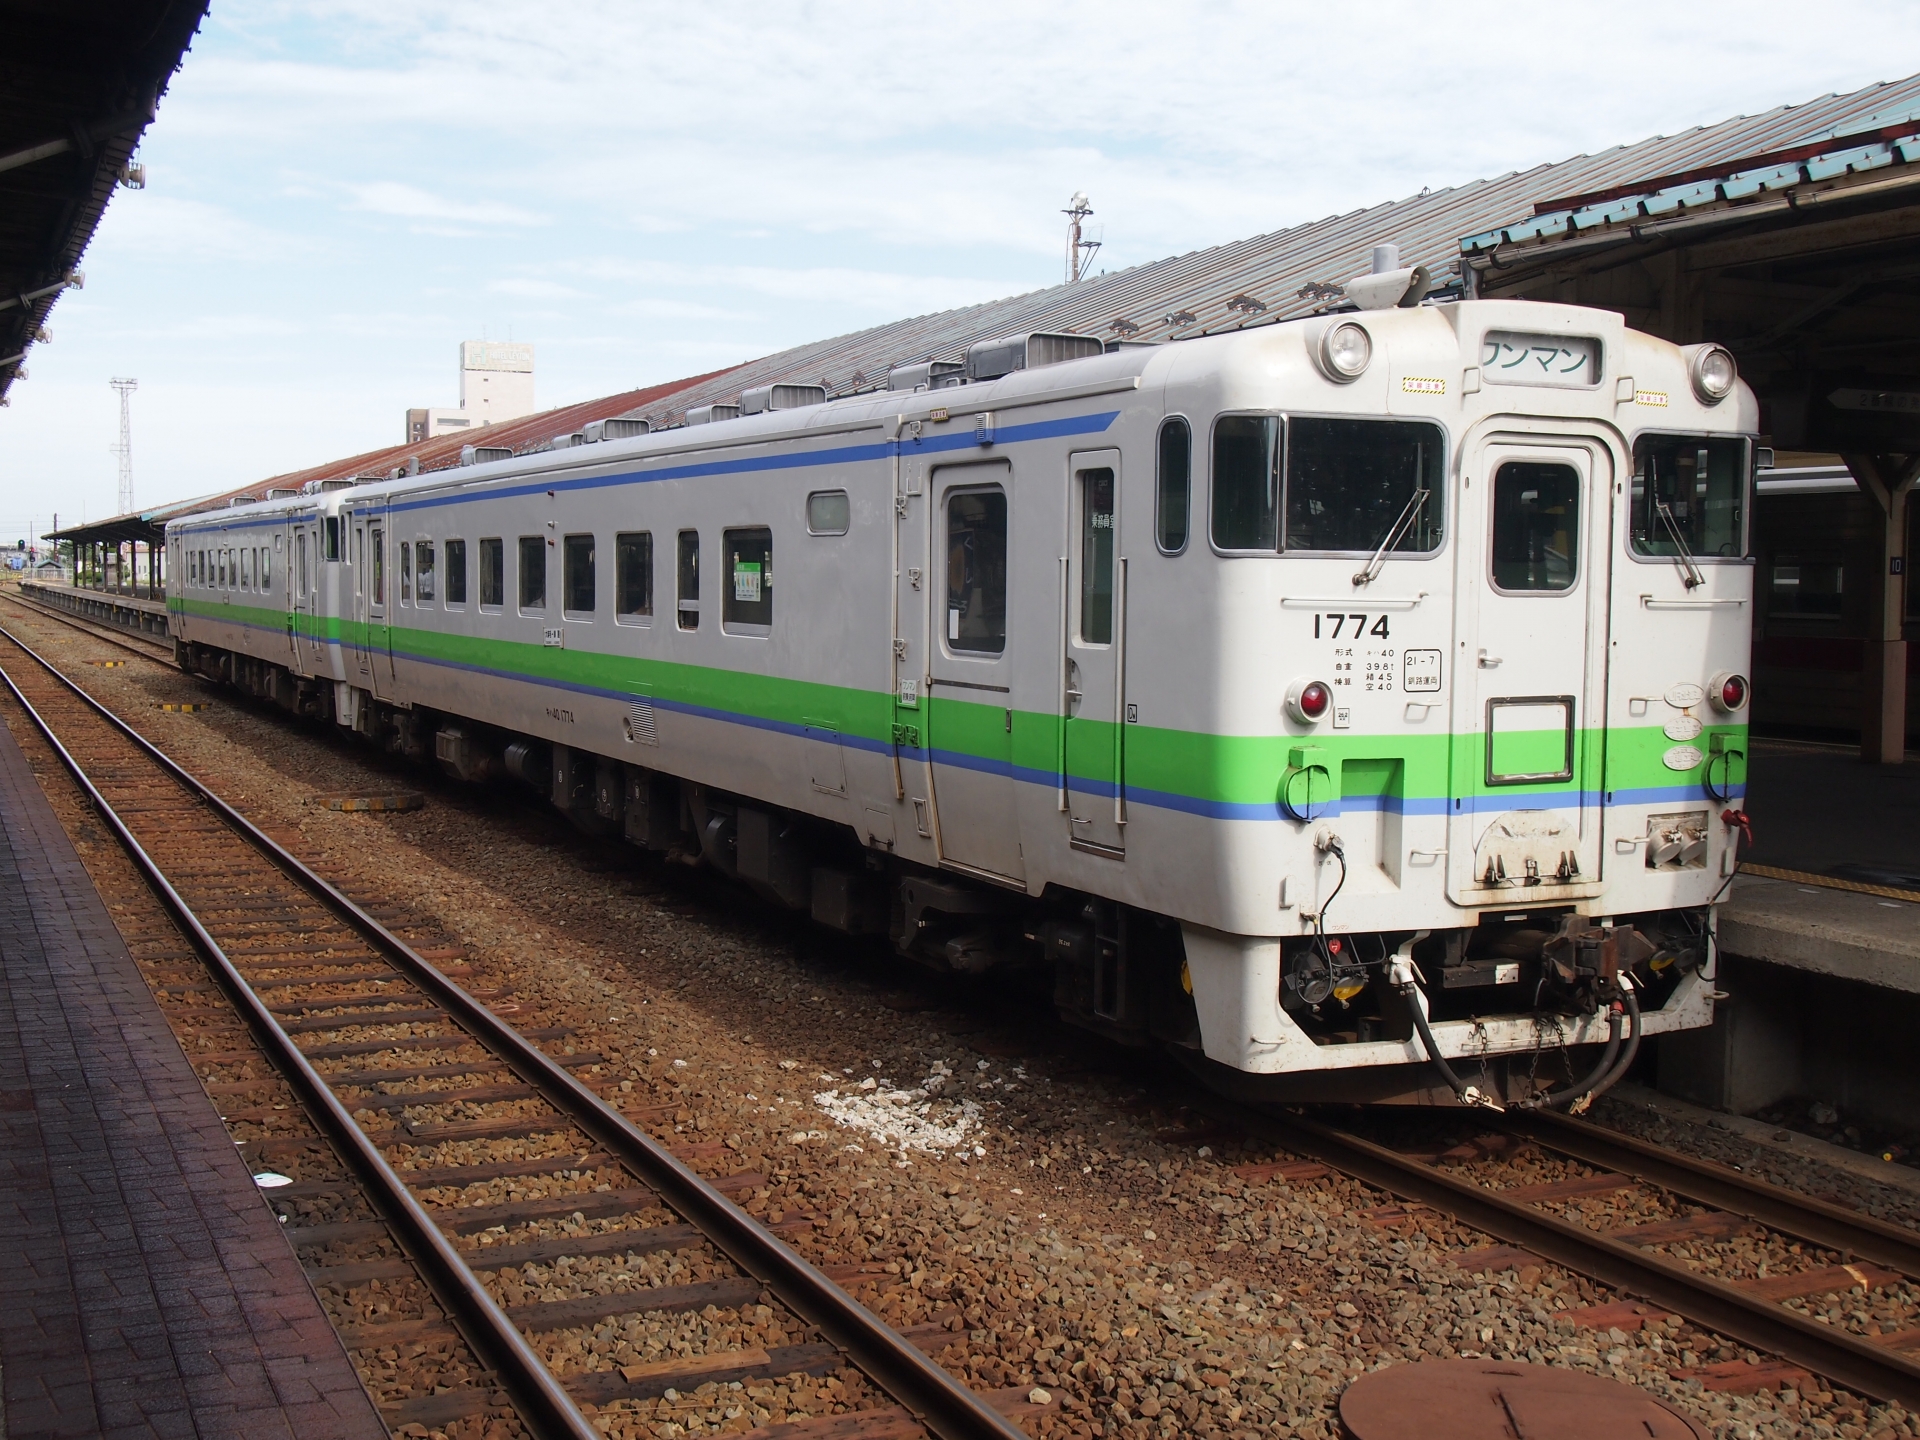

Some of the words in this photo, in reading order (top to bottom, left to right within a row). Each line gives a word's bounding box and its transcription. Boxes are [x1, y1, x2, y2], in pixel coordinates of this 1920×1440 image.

[1891, 559, 1902, 572] 10
[1314, 613, 1390, 640] 1774
[1335, 662, 1352, 671] 自重
